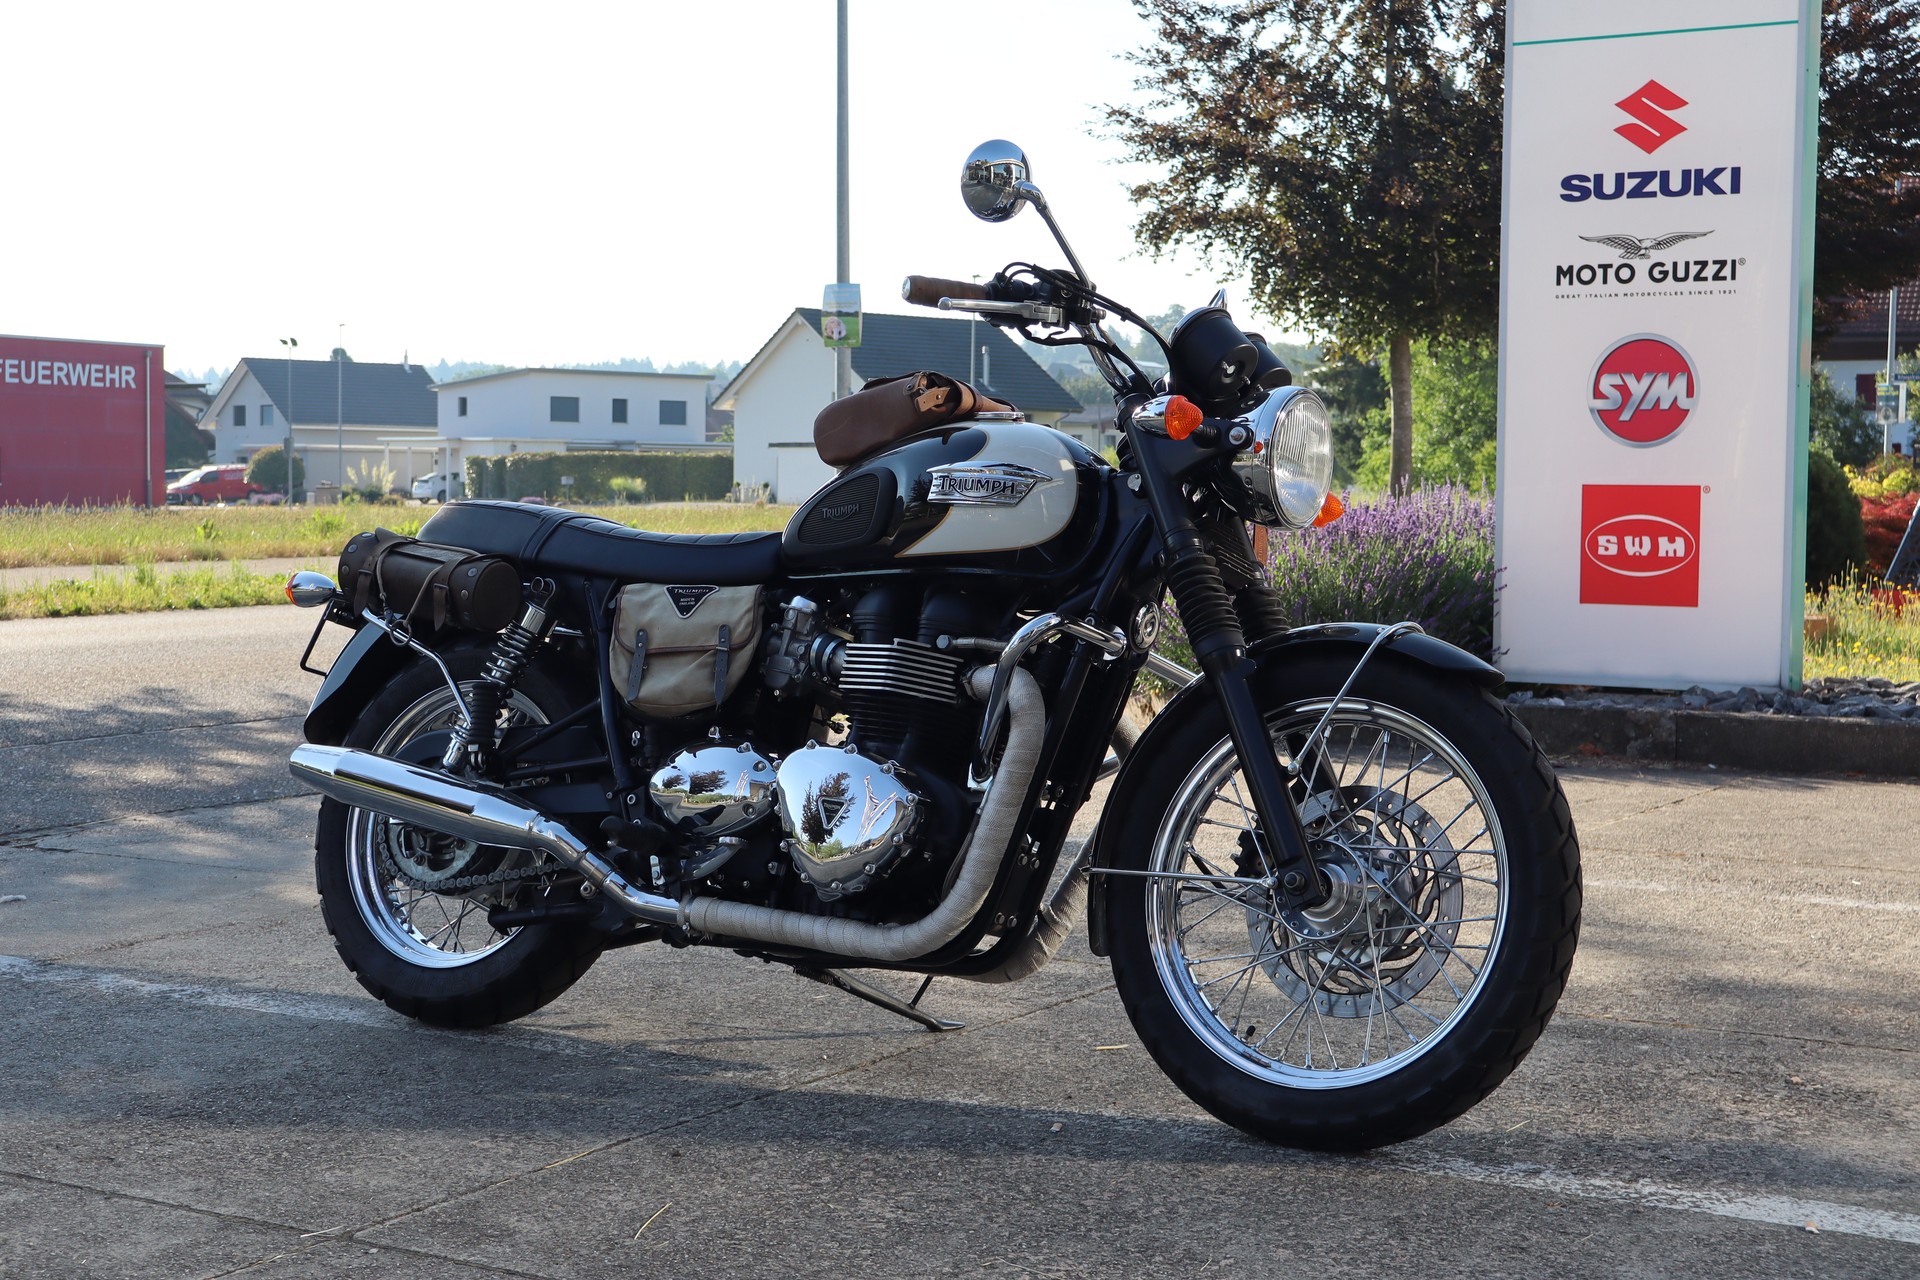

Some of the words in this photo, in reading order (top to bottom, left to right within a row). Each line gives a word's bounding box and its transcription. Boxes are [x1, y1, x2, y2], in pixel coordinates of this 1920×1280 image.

[1560, 166, 1741, 202] SUZUKI
[1556, 263, 1636, 286] MOTO
[0, 359, 137, 389] EUERWEHR
[1590, 372, 1696, 422] SYM
[939, 475, 1015, 497] TRIUMPH
[822, 503, 860, 520] TRIUMPH
[1597, 535, 1686, 558] SWM
